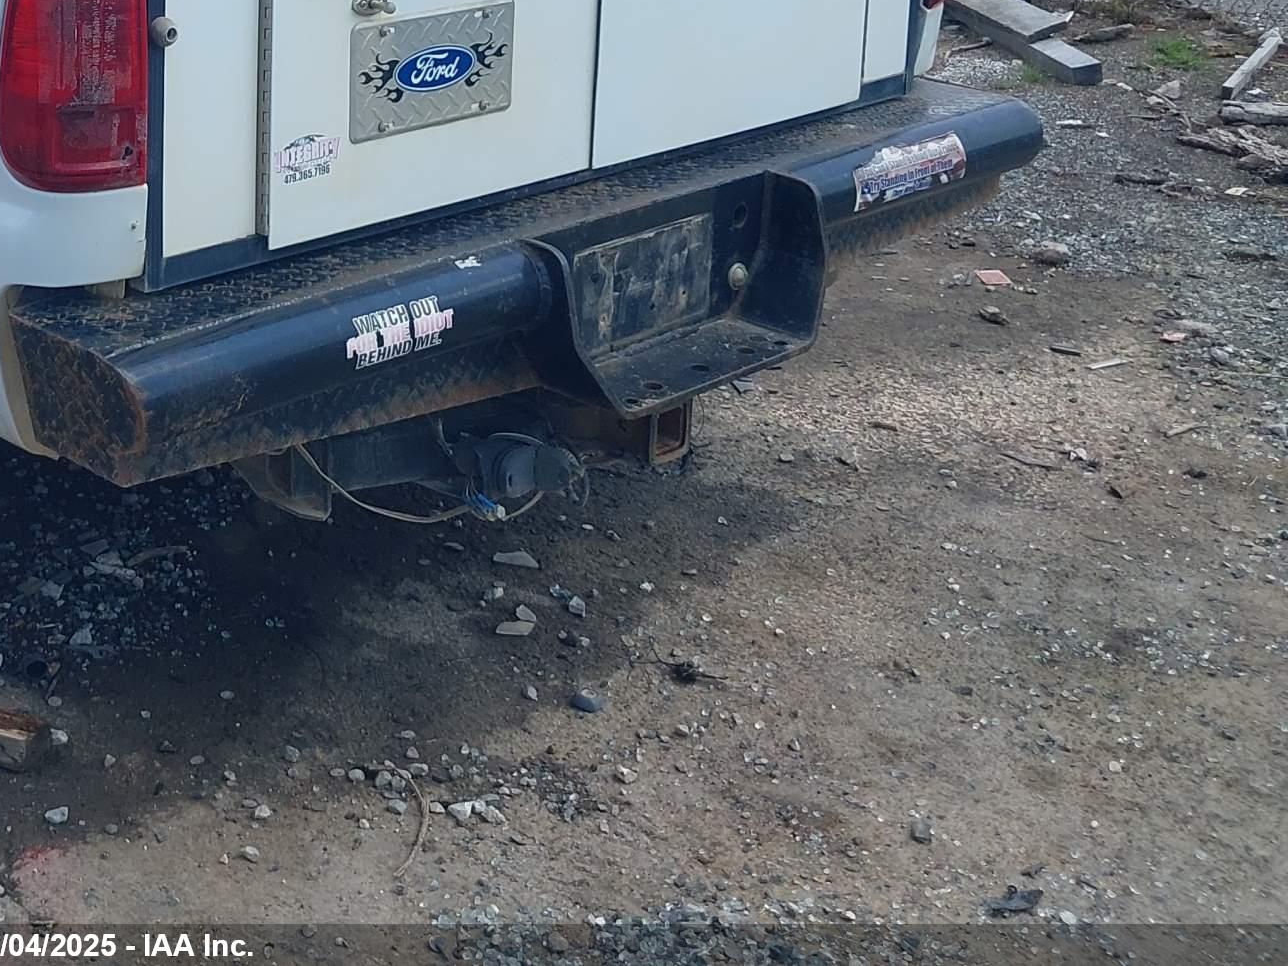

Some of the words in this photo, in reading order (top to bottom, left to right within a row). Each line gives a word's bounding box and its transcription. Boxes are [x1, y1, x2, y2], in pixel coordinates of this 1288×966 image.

[410, 52, 461, 85] Ford
[353, 306, 409, 335] WATCH
[410, 296, 440, 319] OUT
[413, 309, 454, 338] IDIOT
[356, 339, 412, 369] BEHIND
[415, 331, 443, 351] ME.
